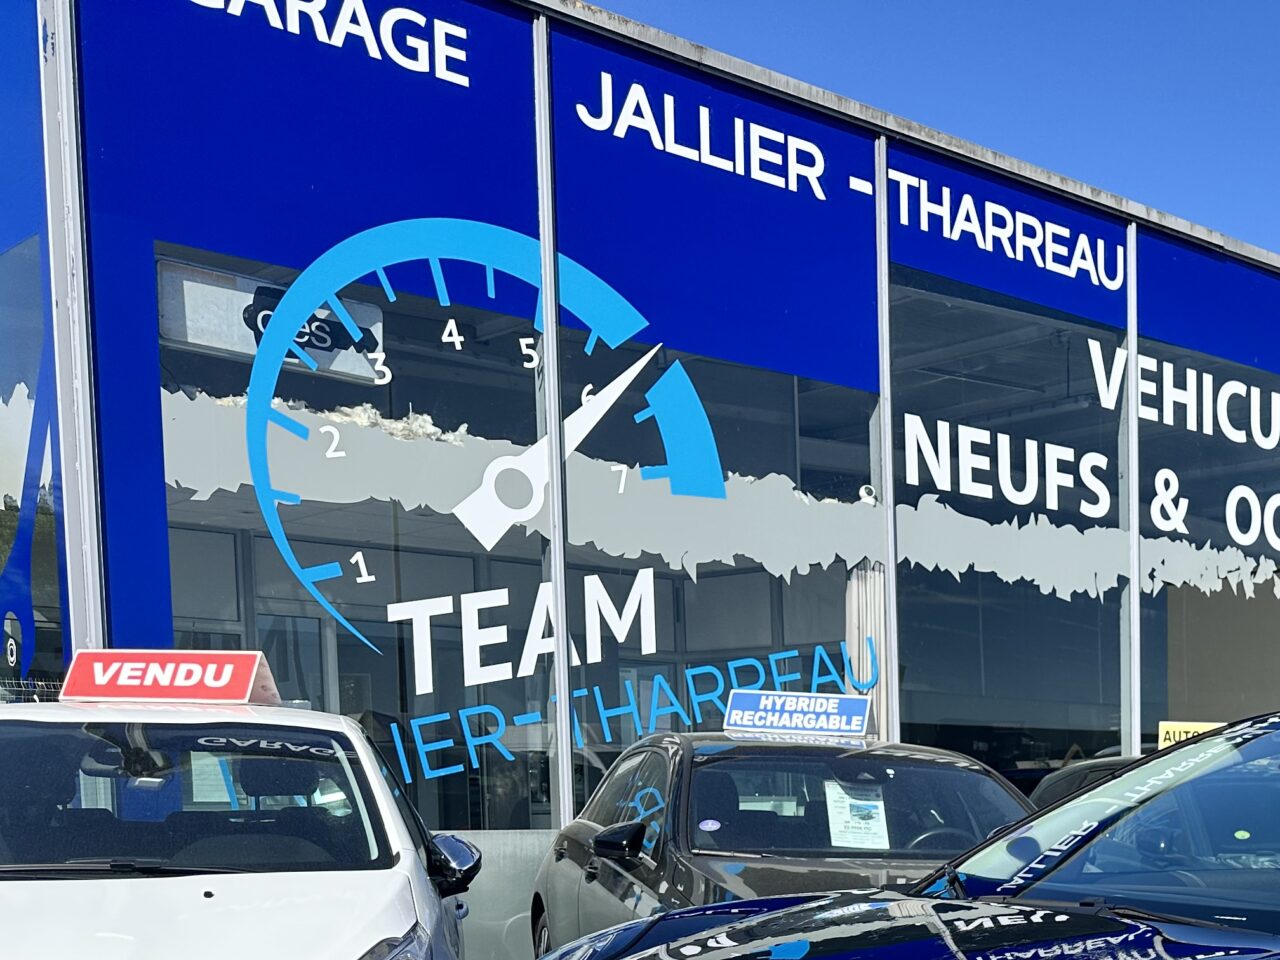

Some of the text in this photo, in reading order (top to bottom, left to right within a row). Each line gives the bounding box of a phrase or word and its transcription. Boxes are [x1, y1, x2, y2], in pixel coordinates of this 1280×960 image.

[575, 71, 826, 200] JALLIER
[888, 170, 1124, 291] THARREAU
[441, 319, 465, 350] 4
[367, 352, 393, 385] 3
[518, 337, 540, 369] 5
[319, 425, 346, 458] 2
[610, 464, 628, 494] 7
[904, 414, 1112, 518] NEUFS
[1150, 468, 1190, 535] &
[349, 551, 375, 583] 1
[387, 567, 657, 696] TEAM
[93, 662, 235, 689] VENDU
[759, 694, 840, 714] HYBRIDE
[729, 710, 864, 732] RECHARGABLE
